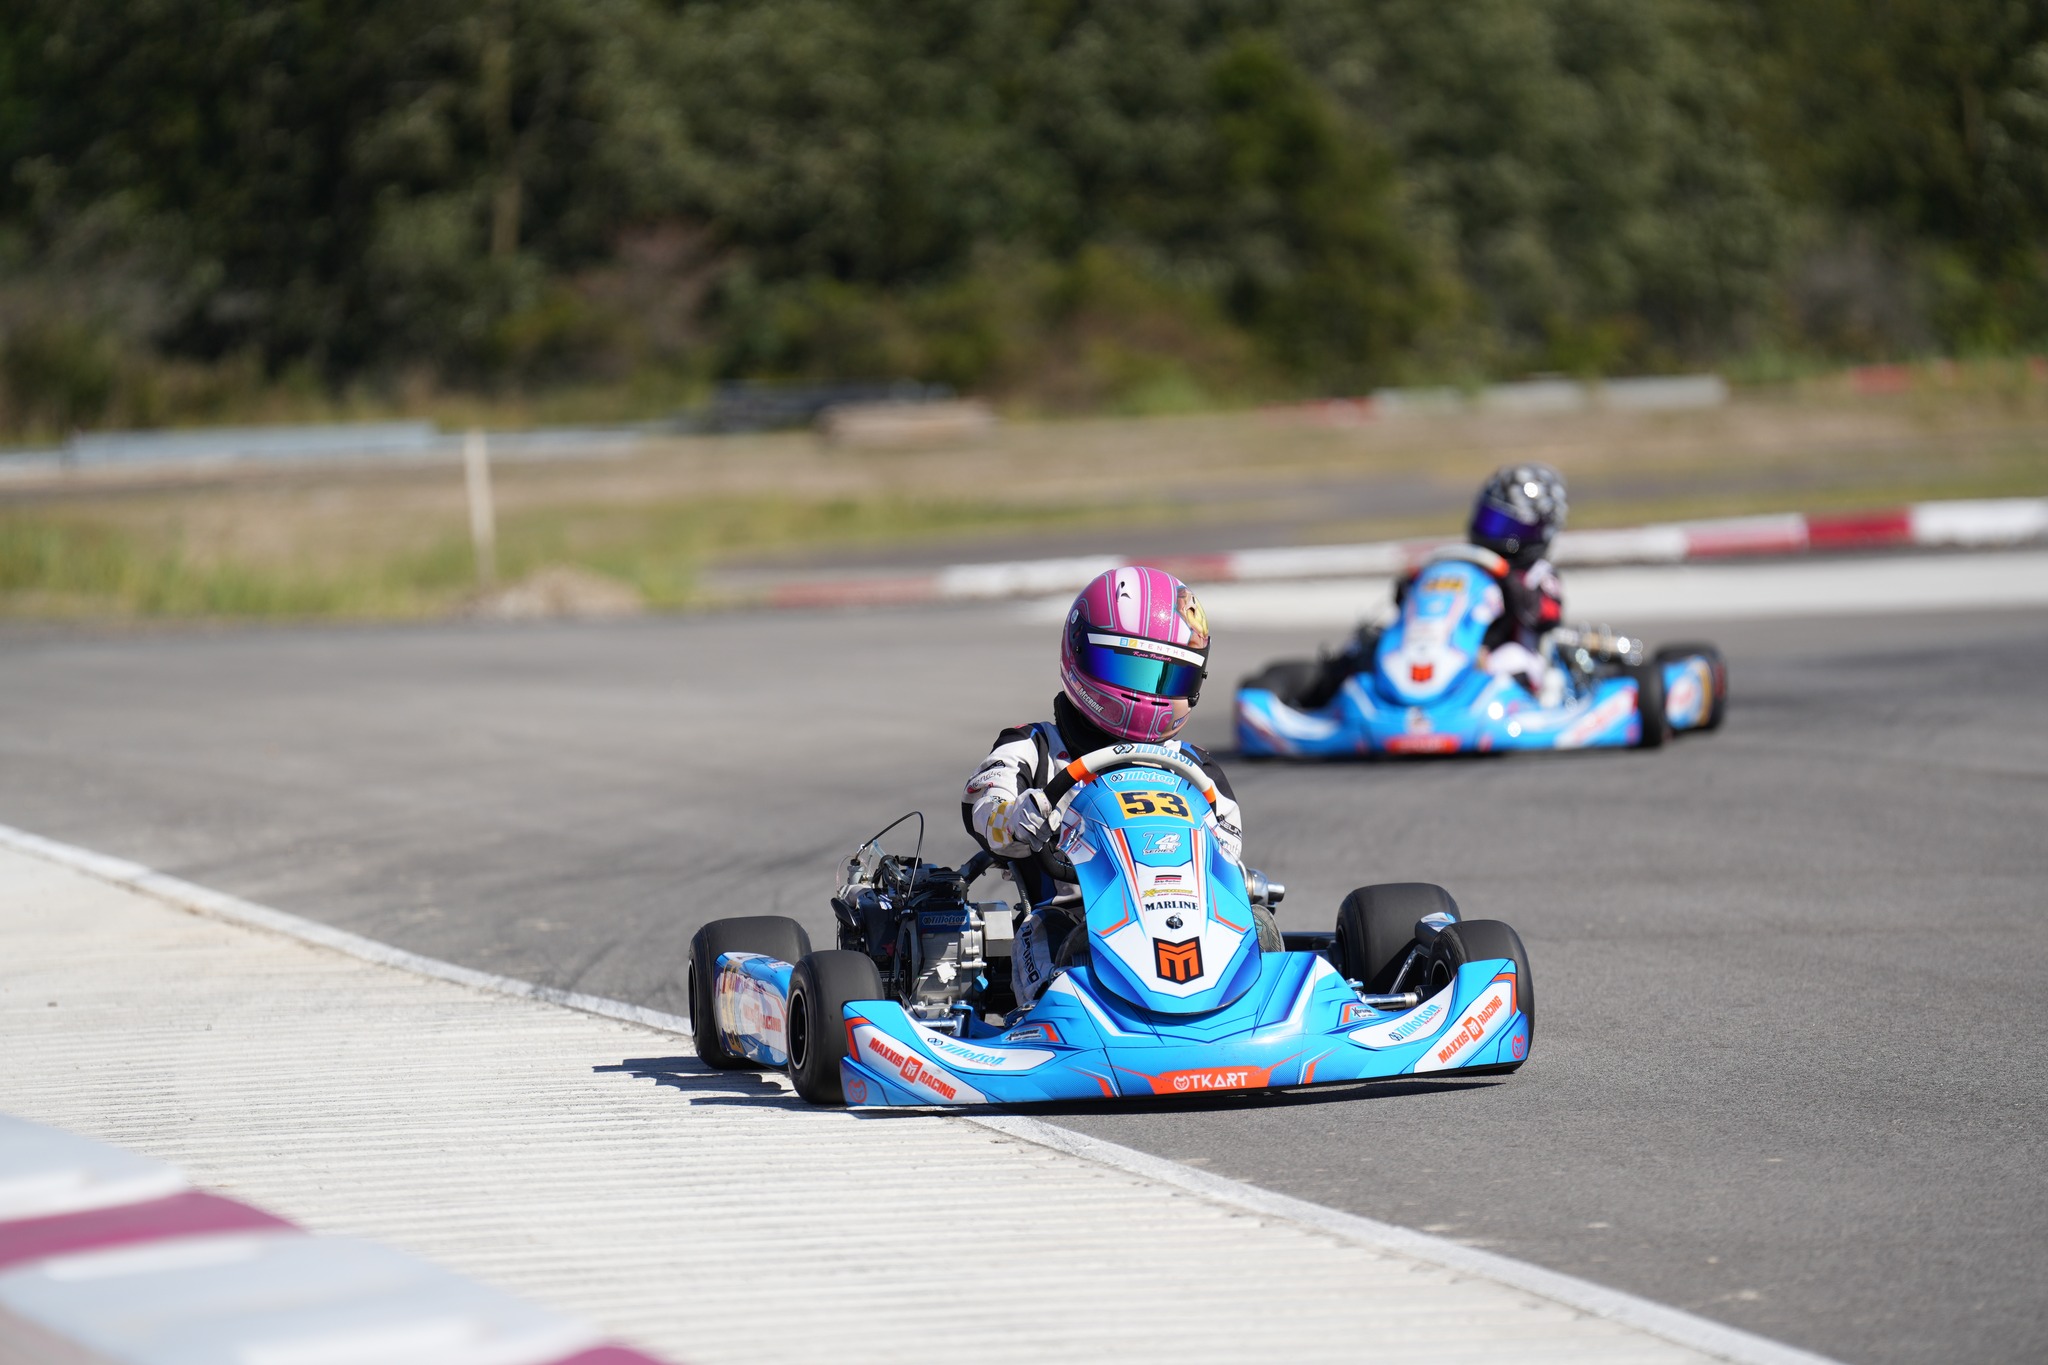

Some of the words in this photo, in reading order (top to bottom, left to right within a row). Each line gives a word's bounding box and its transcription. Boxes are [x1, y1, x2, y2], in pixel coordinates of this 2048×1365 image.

[1139, 642, 1186, 657] TENTHS
[1122, 771, 1174, 783] Tillotson
[1121, 791, 1189, 817] 53
[1144, 901, 1199, 912] MARLINE
[1394, 1004, 1440, 1037] Tillotson
[1437, 1030, 1470, 1064] MAXXIS
[1477, 995, 1503, 1026] RACING
[938, 1043, 1007, 1065] Tillotson
[868, 1037, 905, 1068] MAXXIS
[918, 1069, 957, 1101] RACING
